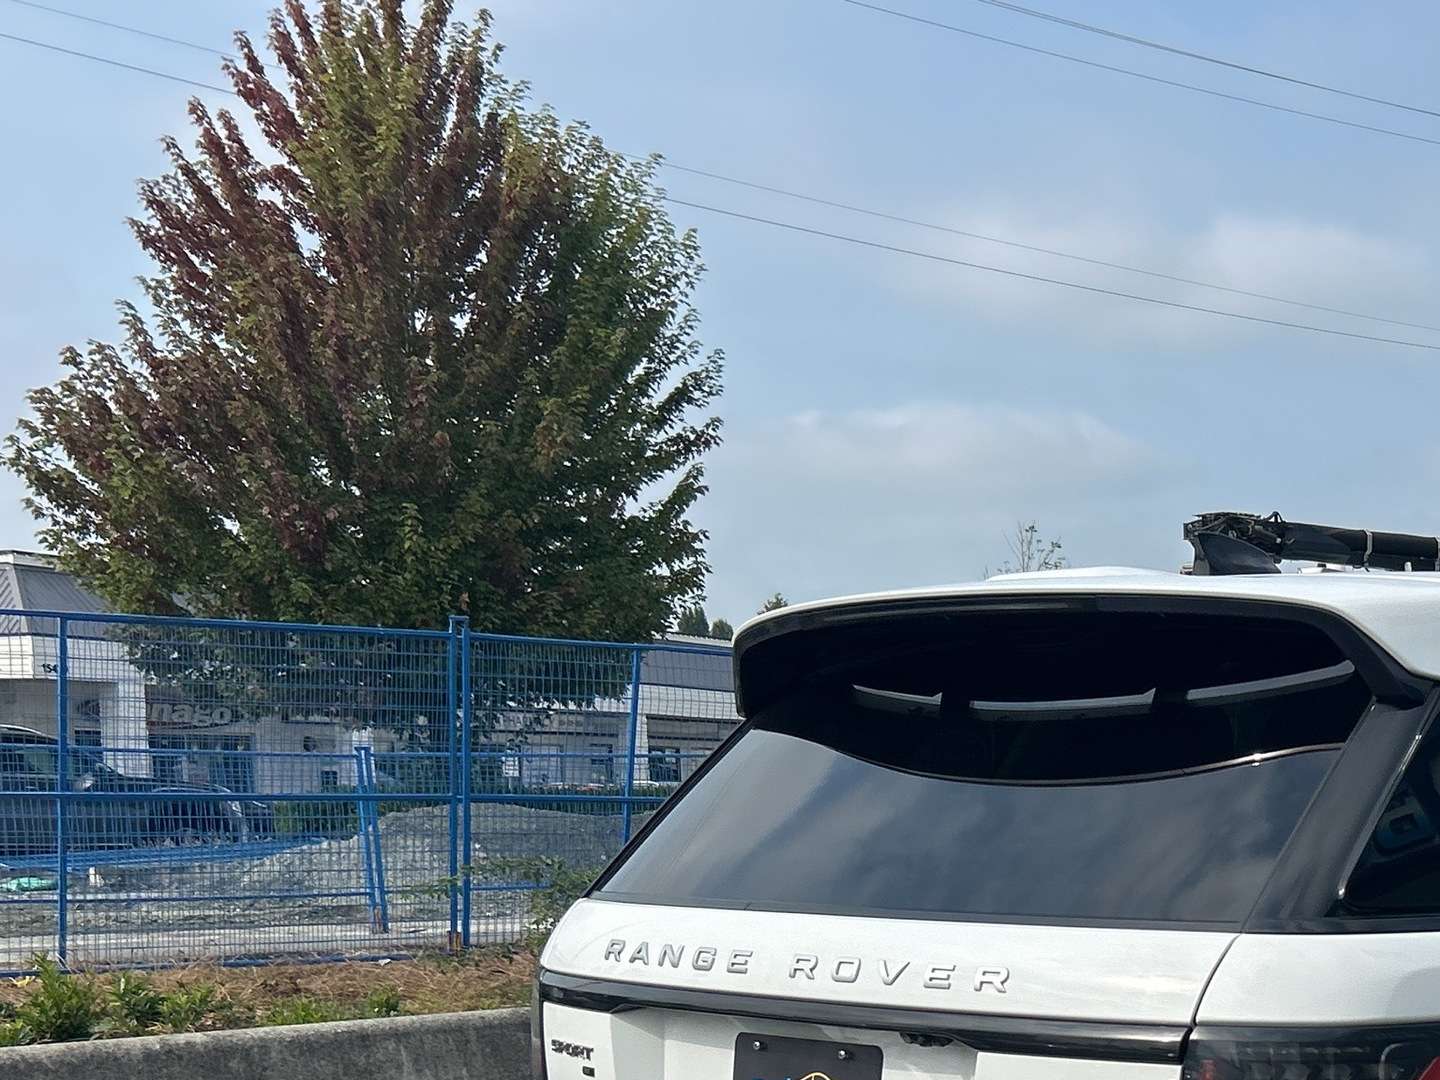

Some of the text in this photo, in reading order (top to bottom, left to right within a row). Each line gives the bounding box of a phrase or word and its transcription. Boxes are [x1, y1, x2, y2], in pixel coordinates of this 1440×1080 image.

[604, 939, 1010, 994] RANGE ROVER
[551, 1039, 595, 1061] SPORT
